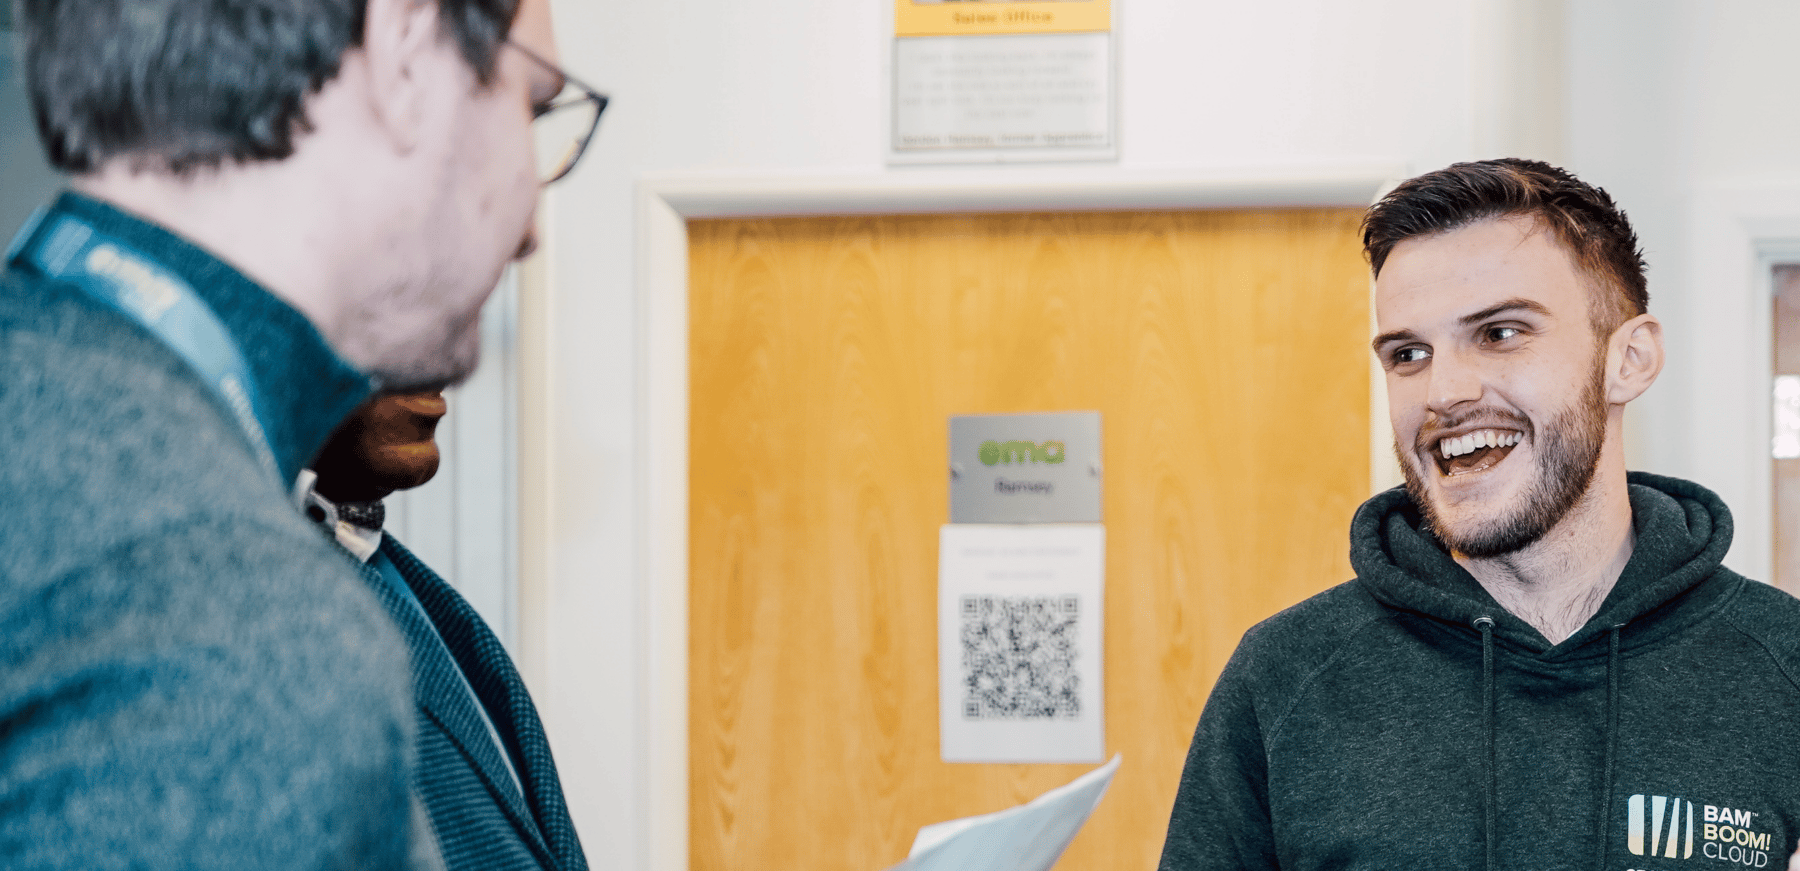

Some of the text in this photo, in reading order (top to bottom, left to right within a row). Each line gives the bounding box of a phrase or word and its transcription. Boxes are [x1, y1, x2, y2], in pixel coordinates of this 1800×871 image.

[977, 440, 1066, 467] ema
[1703, 823, 1772, 851] BOOM!
[1703, 841, 1768, 868] CLOUD
